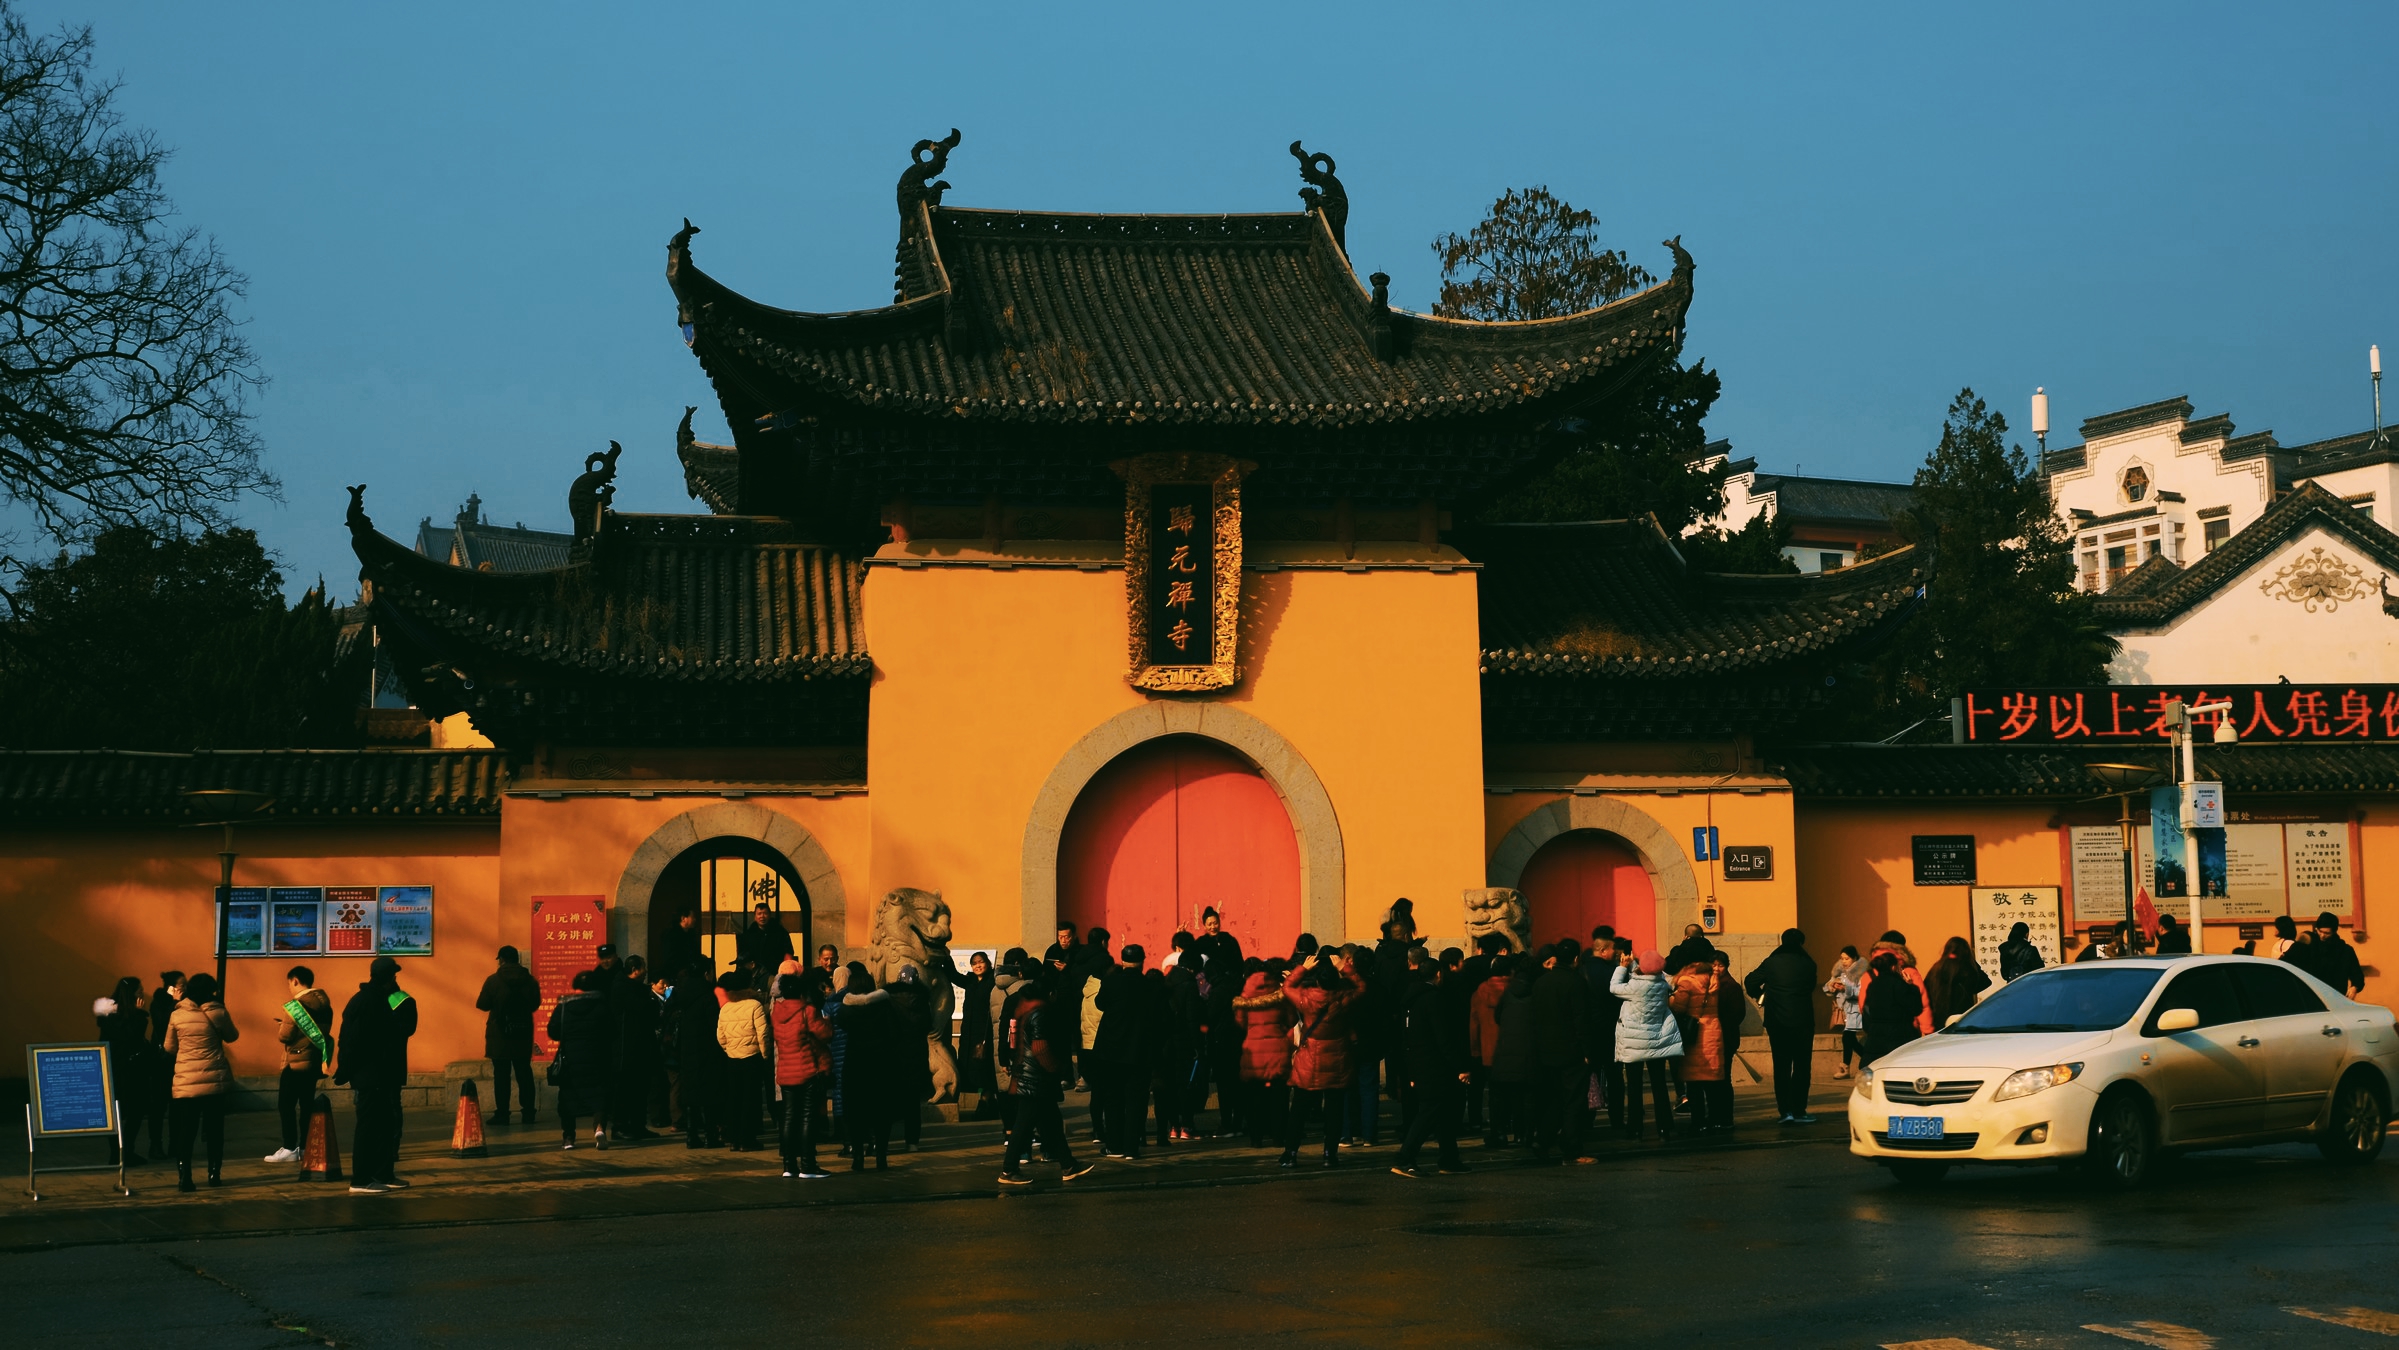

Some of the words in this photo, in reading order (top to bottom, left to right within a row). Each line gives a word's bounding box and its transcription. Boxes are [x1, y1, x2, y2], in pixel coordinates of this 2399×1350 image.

[1166, 504, 1197, 652] 歸元禪寺
[2306, 829, 2328, 837] 敬告
[1731, 854, 1749, 863] 入口
[748, 872, 777, 901] 佛
[1993, 892, 2038, 906] 敬告
[545, 912, 593, 924] 归元禅寺
[545, 930, 594, 941] 义务讲解
